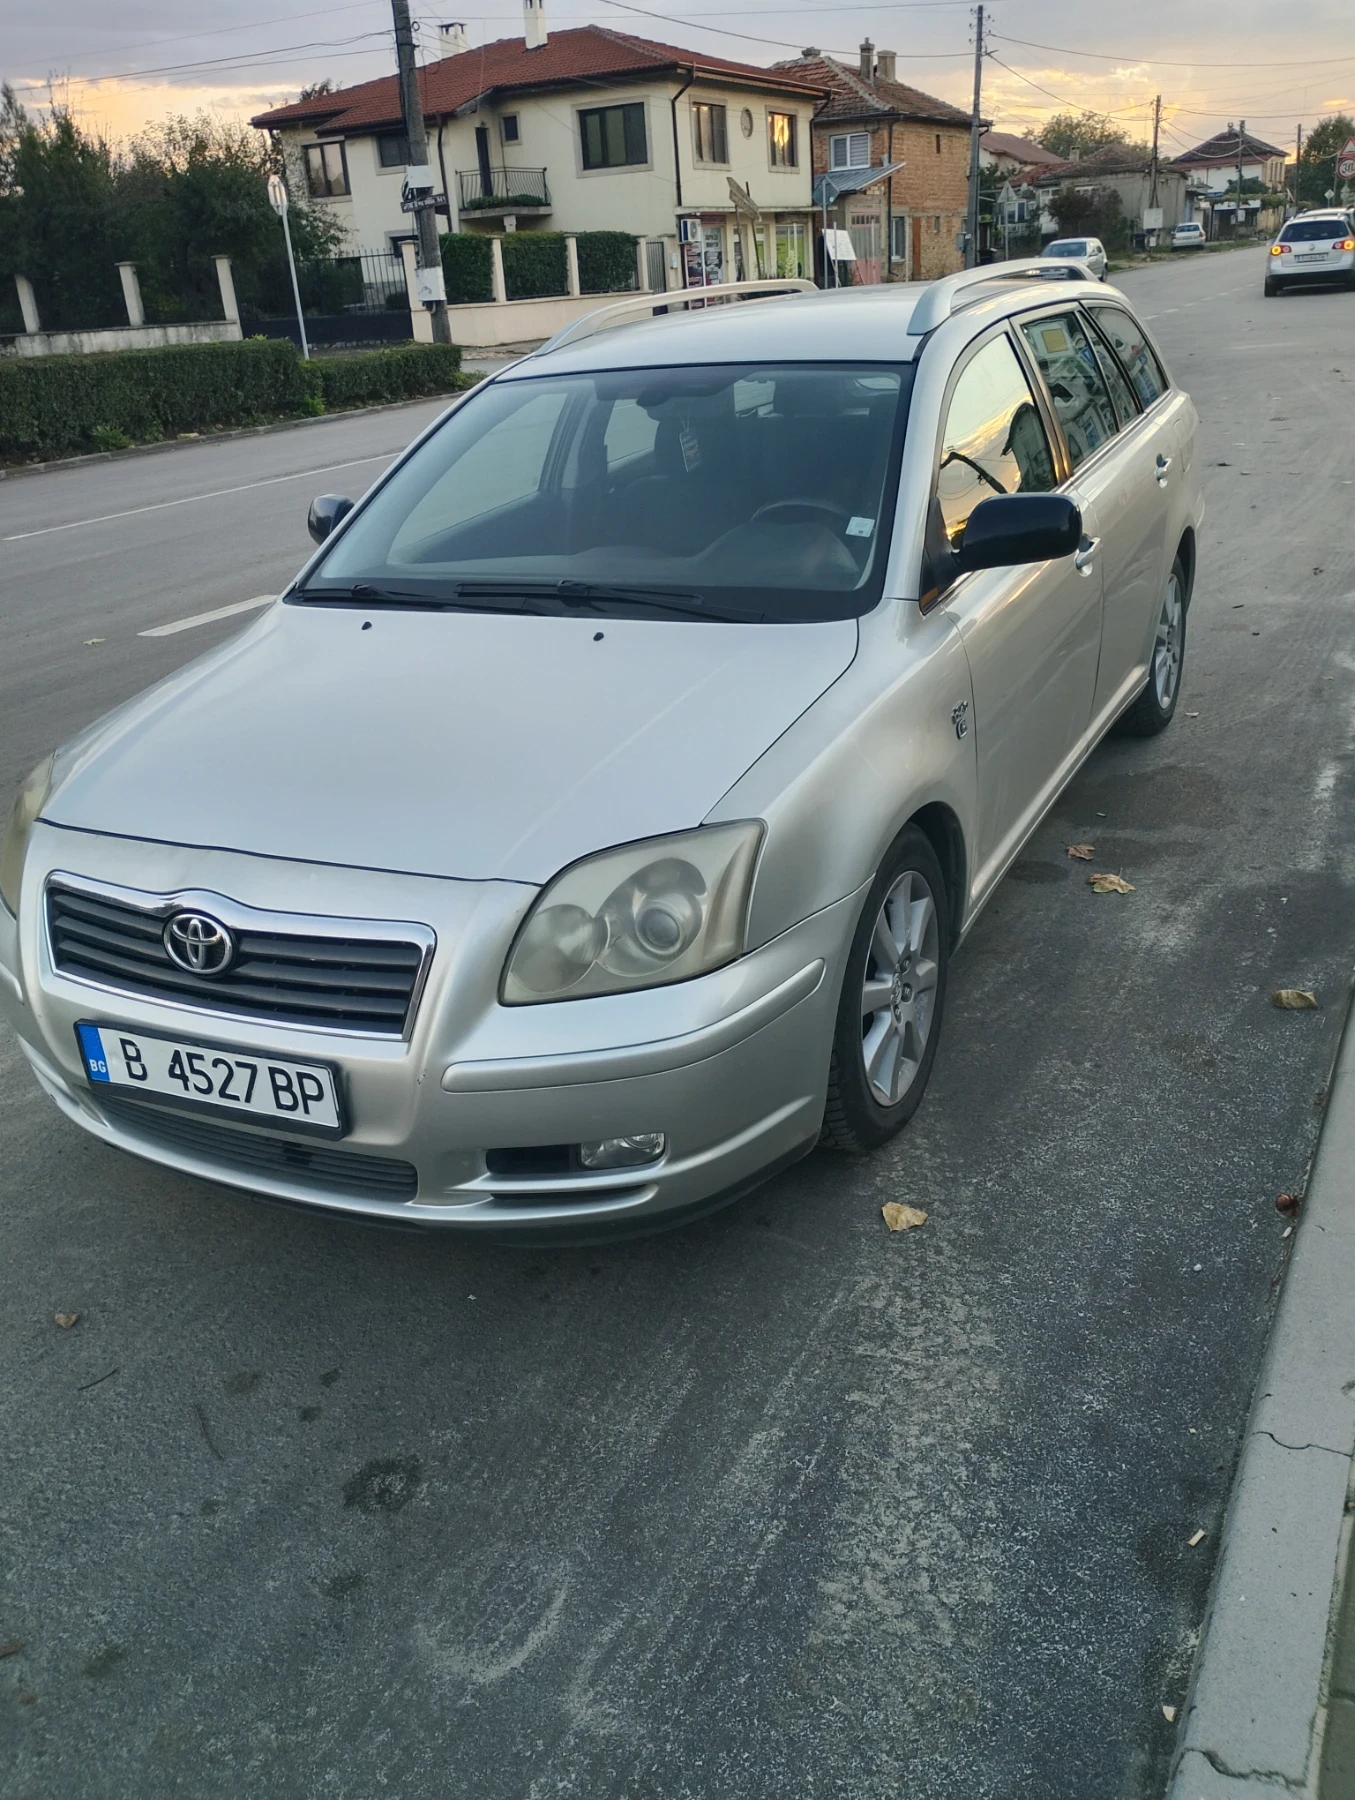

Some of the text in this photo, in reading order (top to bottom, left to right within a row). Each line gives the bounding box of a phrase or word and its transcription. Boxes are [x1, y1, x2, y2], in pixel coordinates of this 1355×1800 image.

[89, 1058, 107, 1074] BG
[119, 1037, 325, 1115] B 4527 BP
